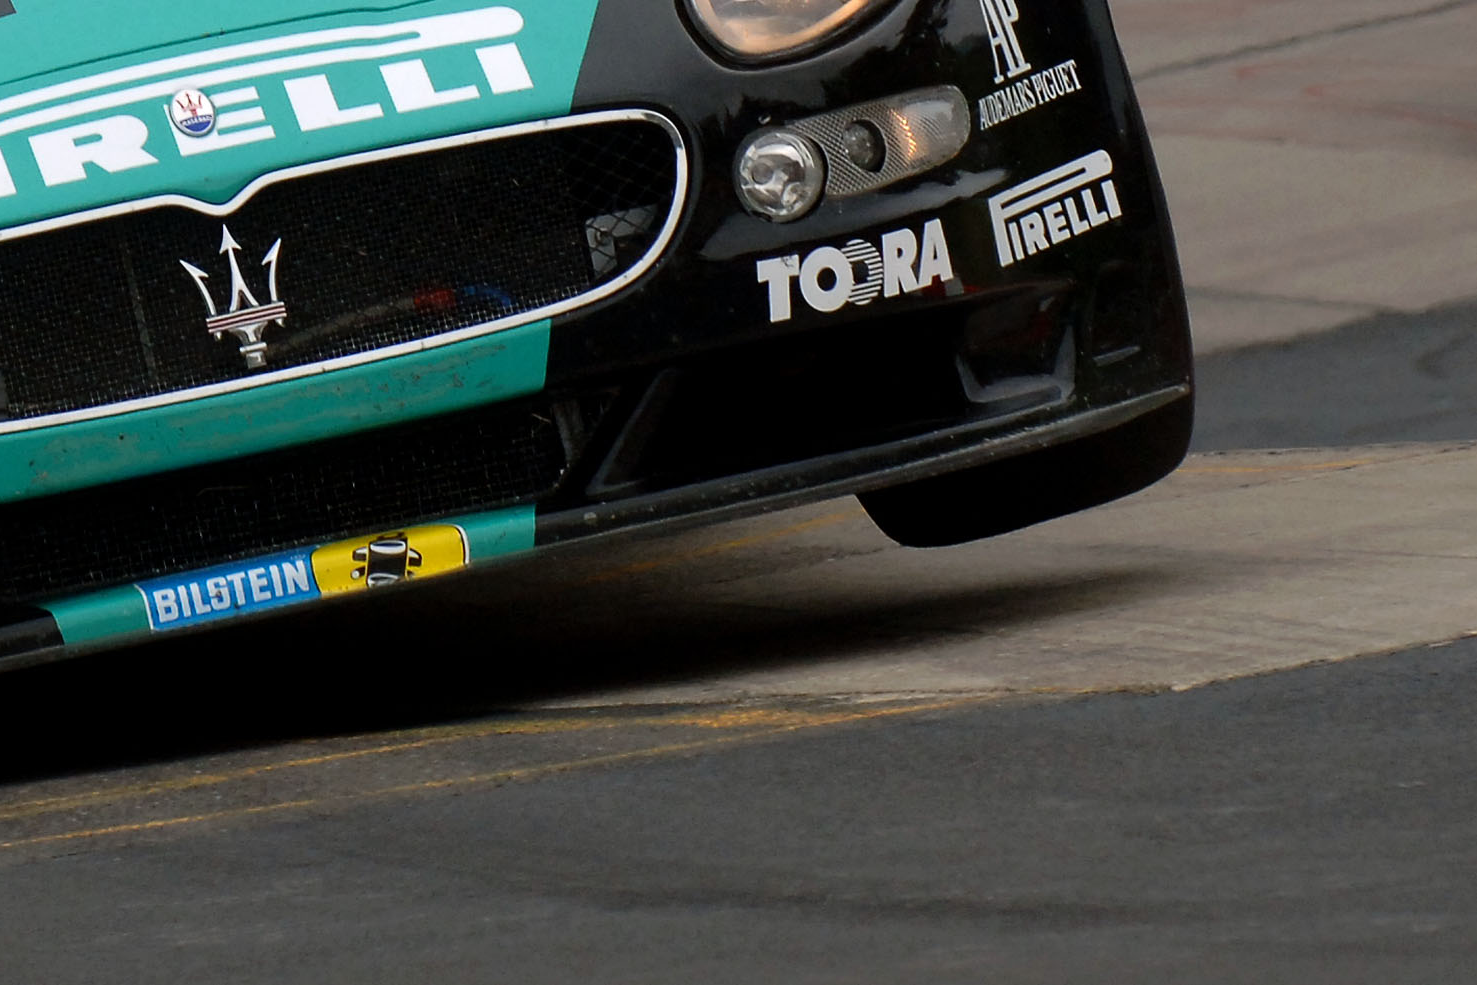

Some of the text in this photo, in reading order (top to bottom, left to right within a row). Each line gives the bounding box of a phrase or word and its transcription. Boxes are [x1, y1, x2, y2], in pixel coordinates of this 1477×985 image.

[978, 59, 1083, 131] AUDEMARS PIGUET
[988, 148, 1122, 268] PIRELLI
[757, 218, 955, 324] TOORA
[152, 558, 311, 624] BILSTEIN
